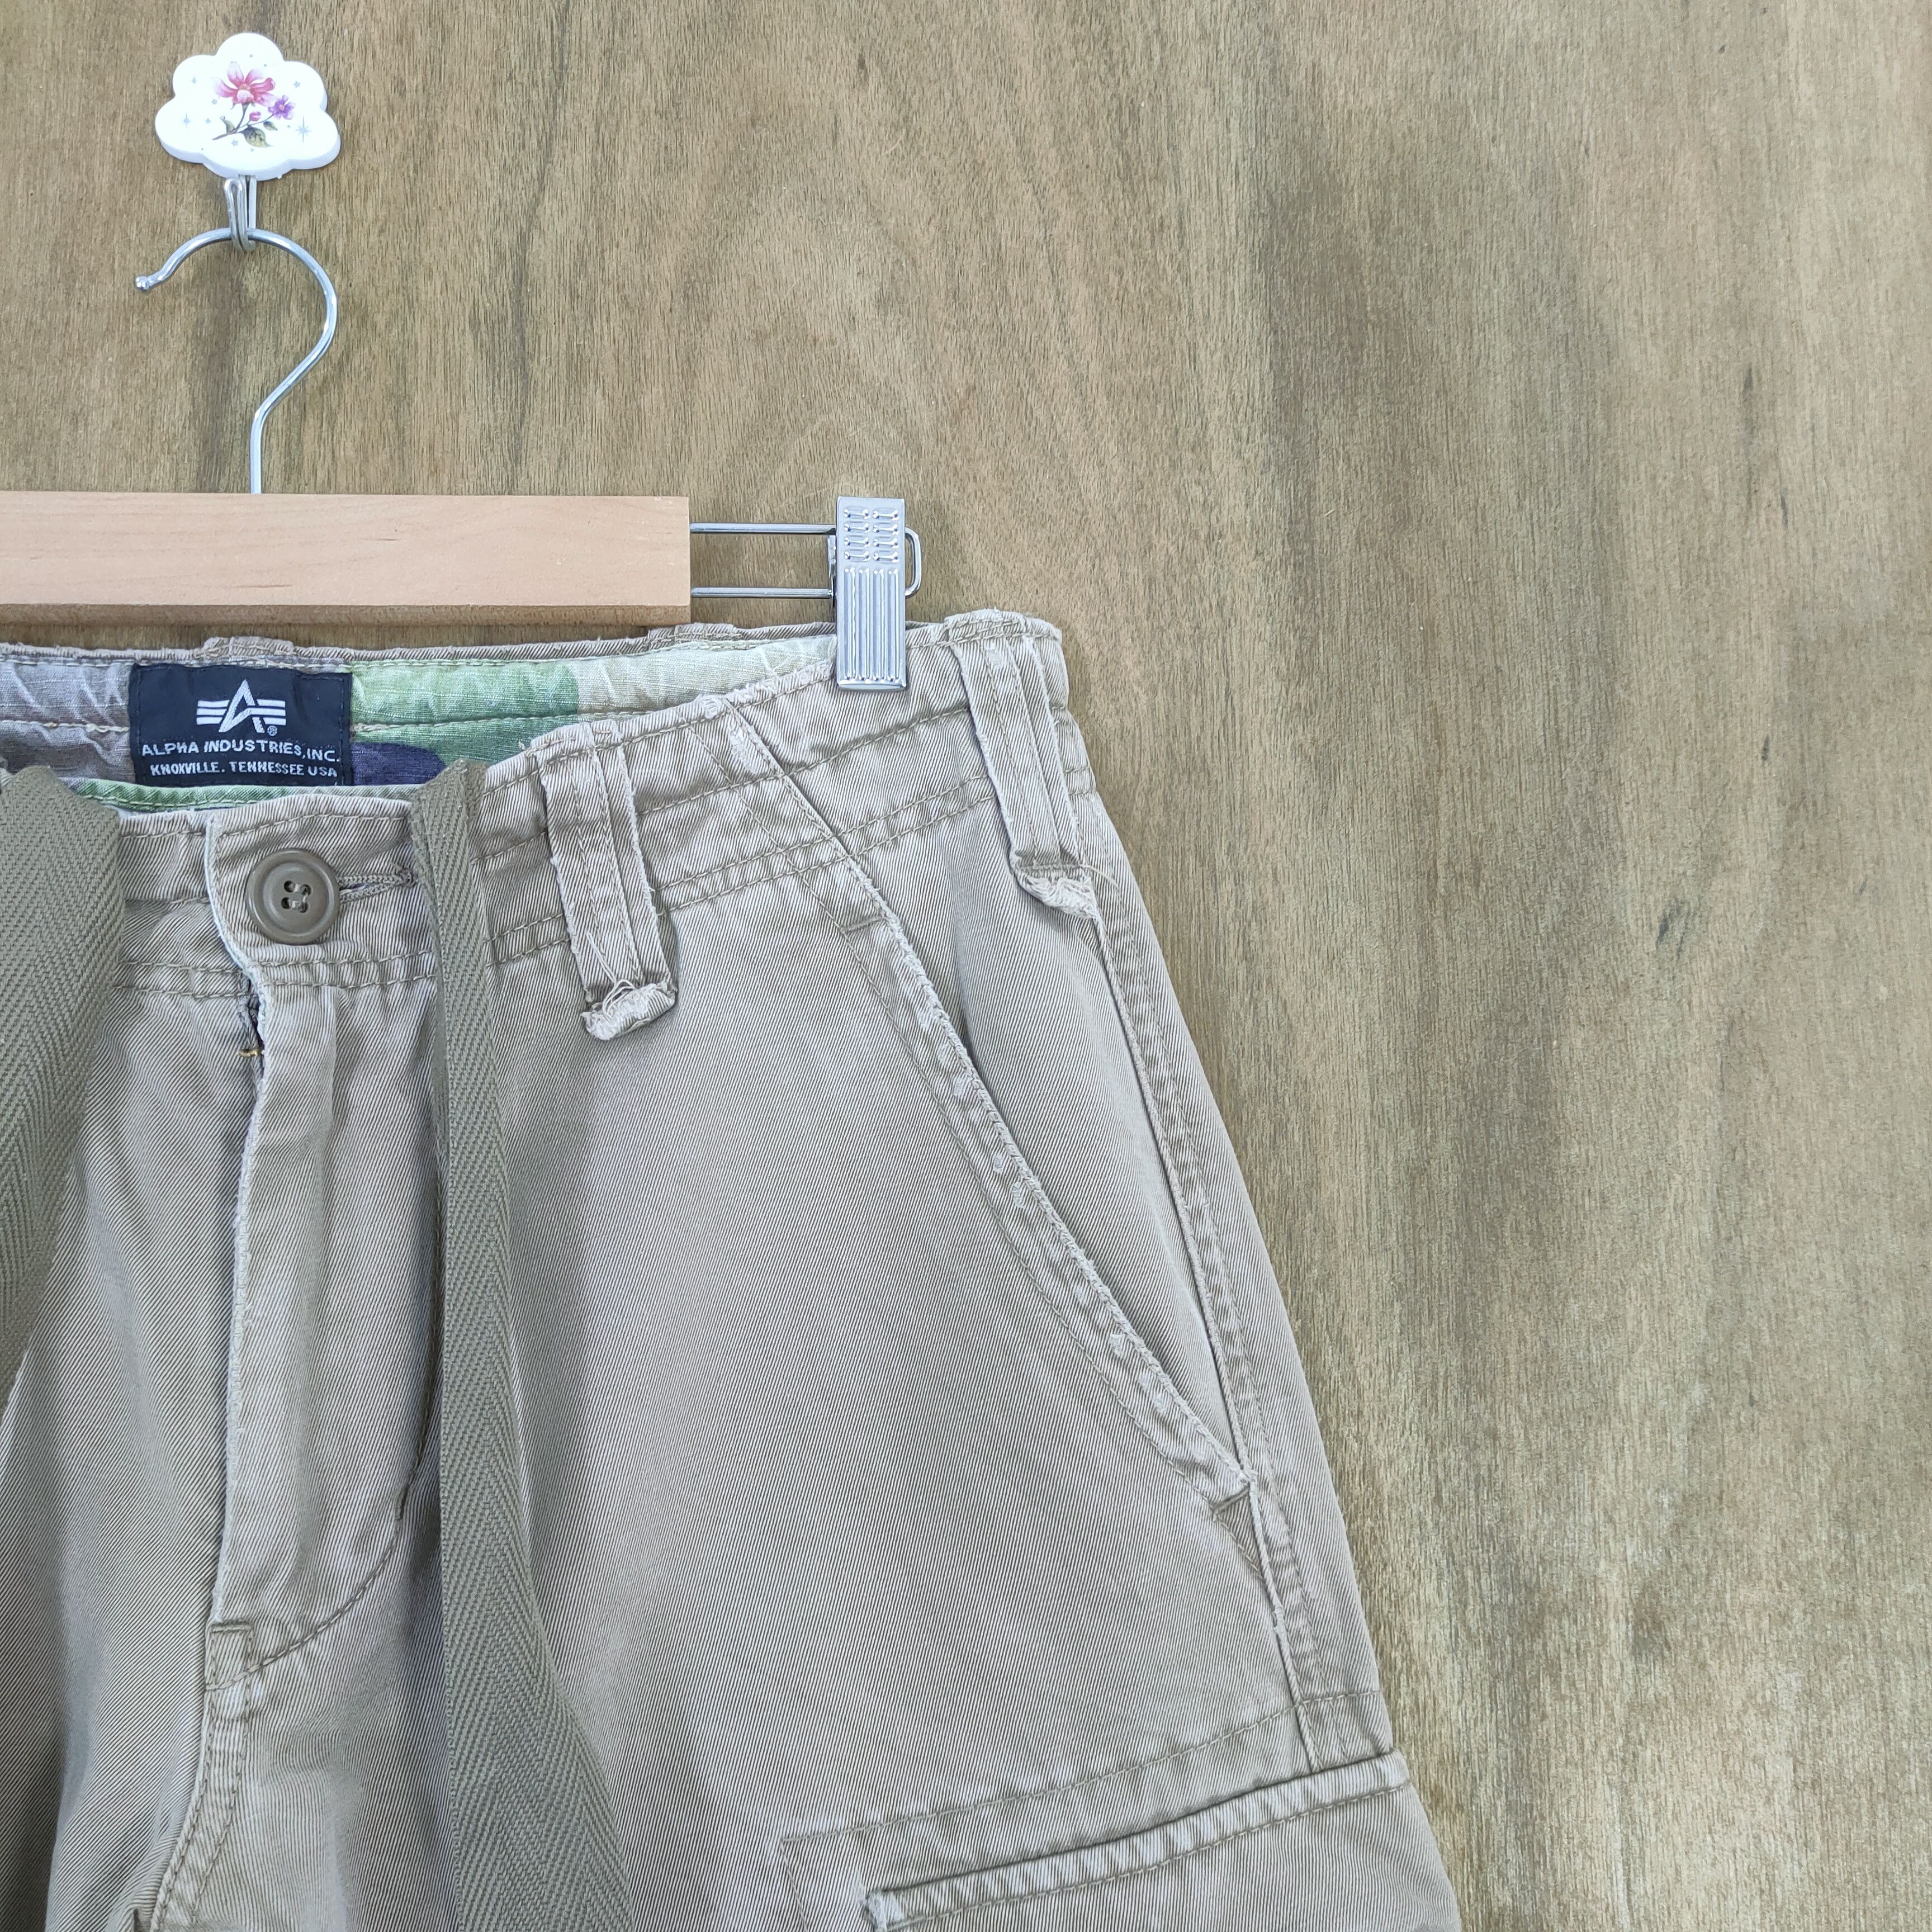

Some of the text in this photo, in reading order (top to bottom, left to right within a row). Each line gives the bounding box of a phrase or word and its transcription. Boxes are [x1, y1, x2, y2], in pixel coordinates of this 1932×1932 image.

[142, 741, 199, 756] ALPHA
[229, 761, 304, 775] TENNESSEE
[307, 766, 338, 777] USA
